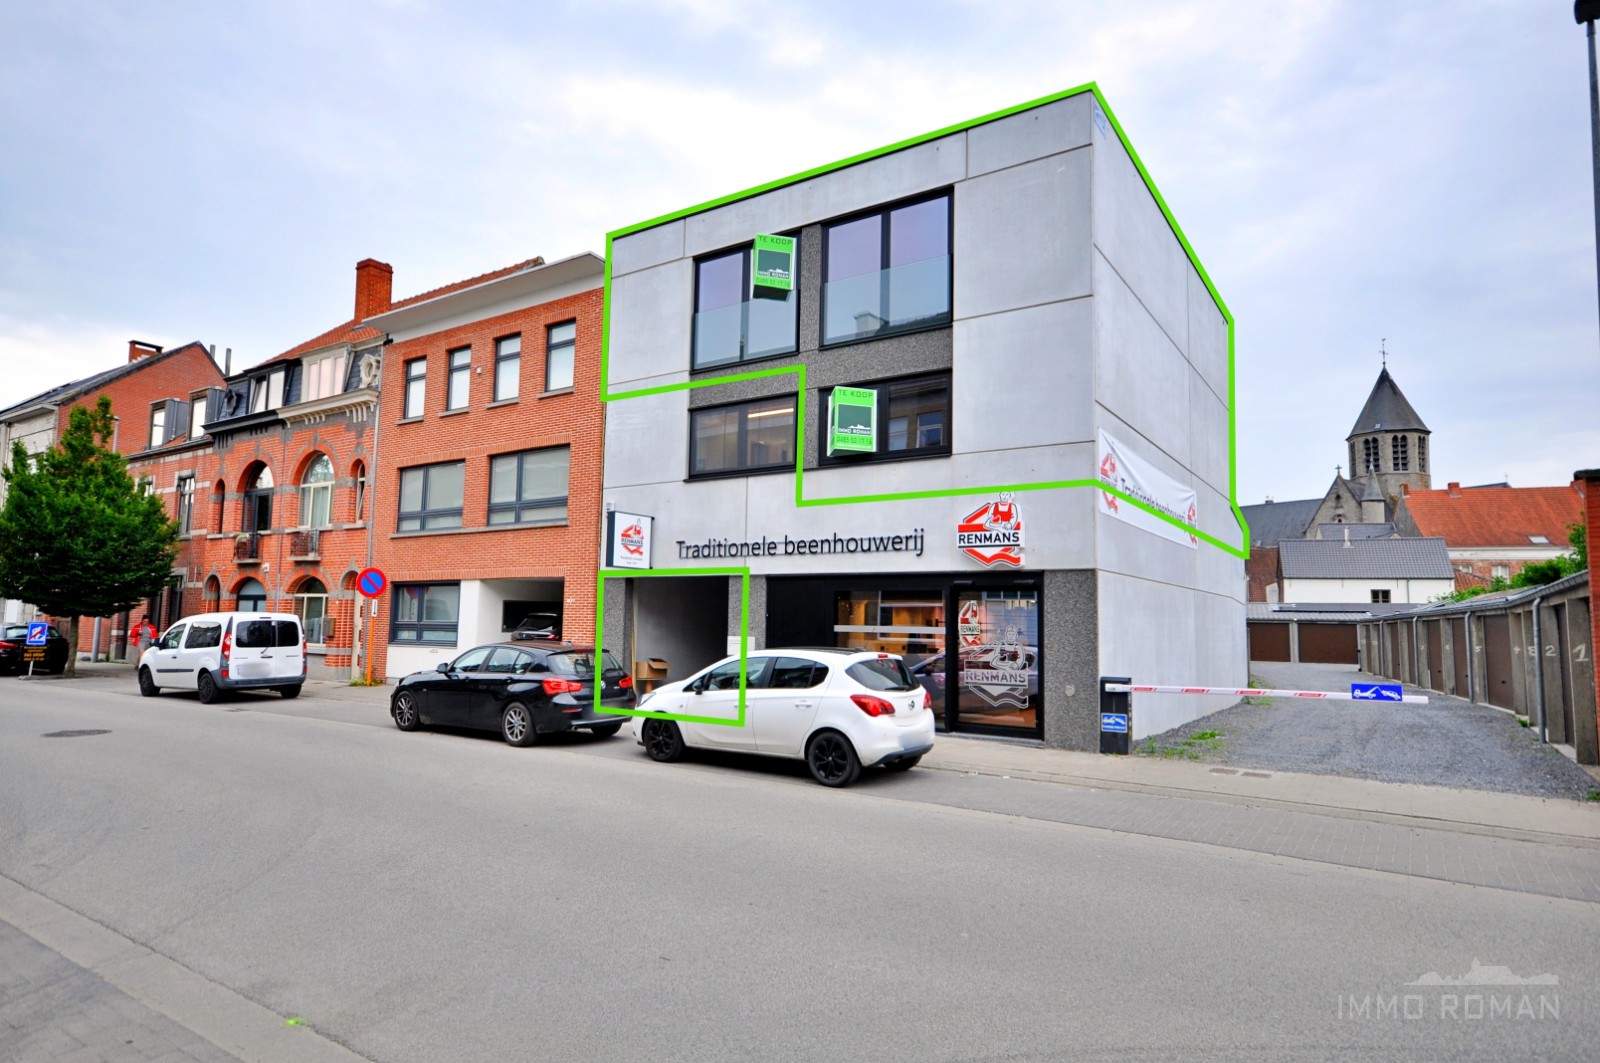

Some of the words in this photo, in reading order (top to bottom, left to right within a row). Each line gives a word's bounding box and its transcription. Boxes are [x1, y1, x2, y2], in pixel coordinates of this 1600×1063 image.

[758, 235, 768, 243] TE
[770, 236, 792, 245] KOOP
[771, 272, 790, 280] ROMAN
[850, 390, 873, 398] KOOP
[620, 537, 644, 545] RENMANS
[676, 535, 778, 559] Traditionele
[784, 528, 925, 557] beenhouwerij
[958, 531, 1020, 545] RENMANS
[960, 624, 980, 634] RENMANS
[1545, 645, 1556, 657] 2
[1572, 643, 1589, 662] 1
[965, 669, 1027, 684] RENMANS
